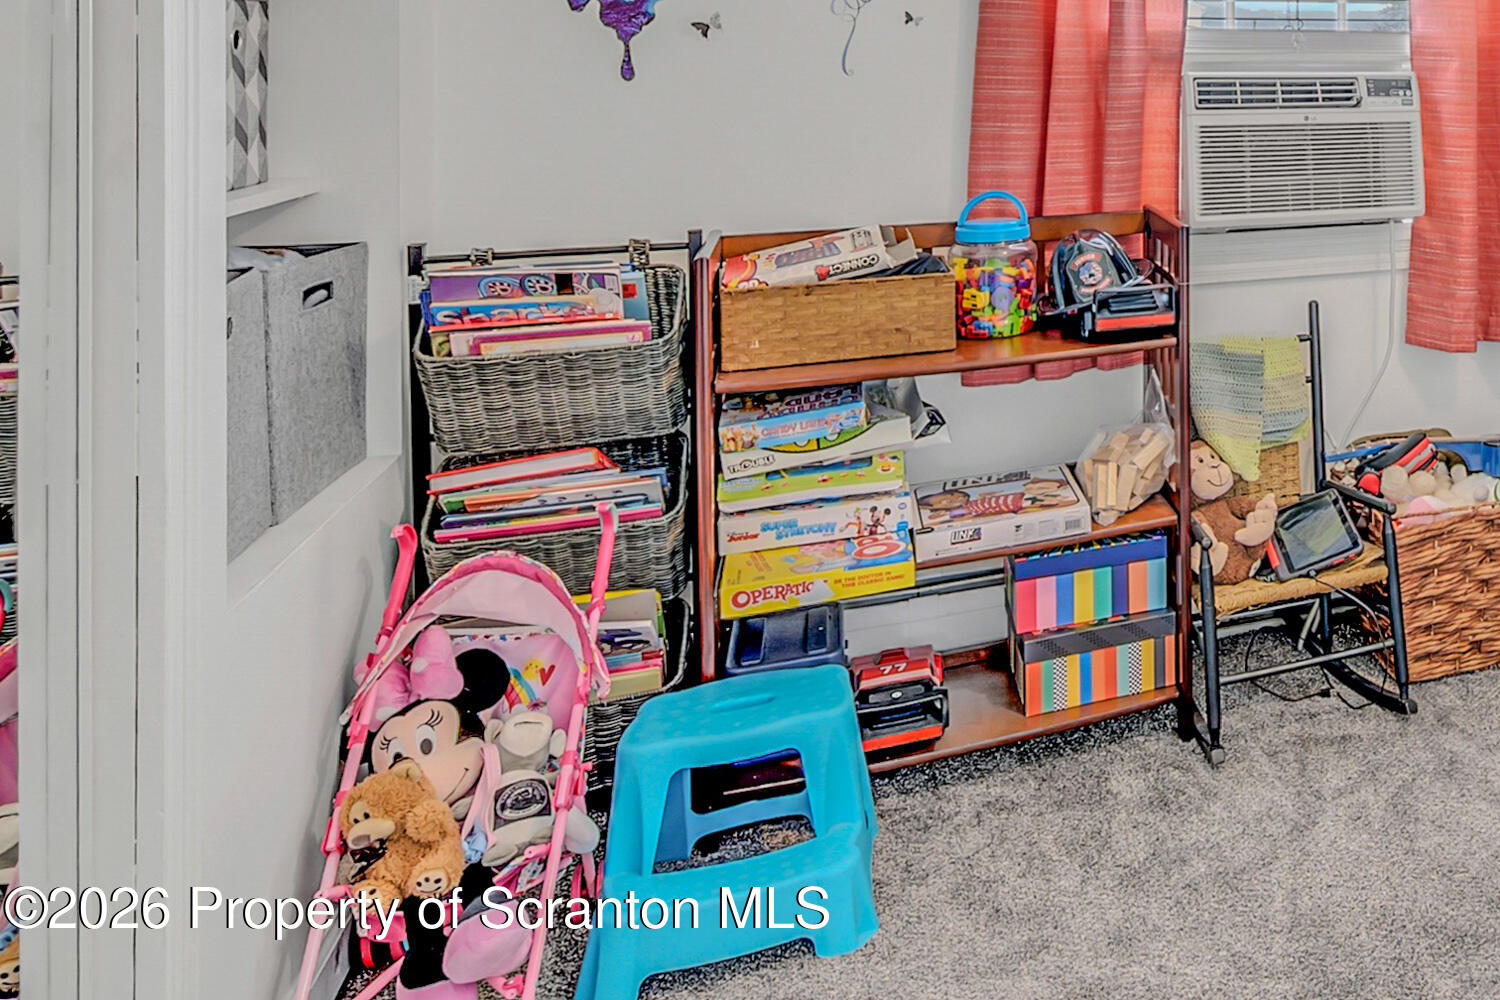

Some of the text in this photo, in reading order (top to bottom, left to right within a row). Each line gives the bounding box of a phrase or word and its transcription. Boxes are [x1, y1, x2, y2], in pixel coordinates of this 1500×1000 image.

[815, 254, 880, 282] CONNECT 4
[760, 421, 798, 438] CANDY
[727, 454, 776, 475] TROUBLE
[760, 517, 799, 533] SUPER
[731, 580, 828, 609] OPERATIO
[880, 662, 907, 675] 77
